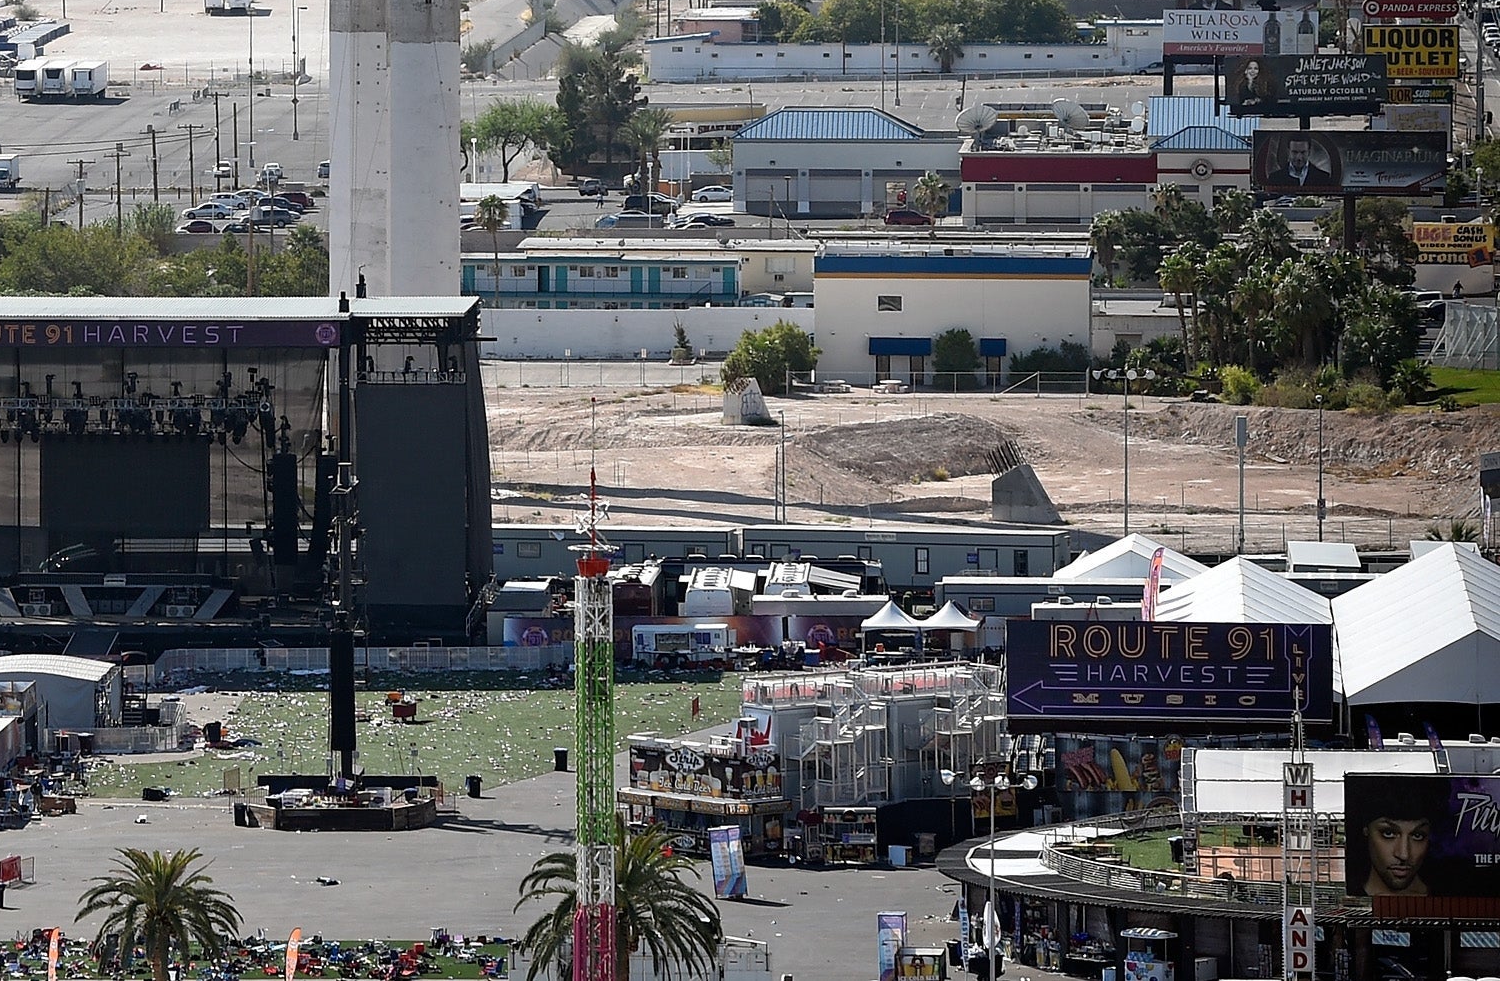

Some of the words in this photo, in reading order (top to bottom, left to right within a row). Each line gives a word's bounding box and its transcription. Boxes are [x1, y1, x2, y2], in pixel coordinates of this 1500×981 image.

[1382, 3, 1415, 12] PANDA
[1417, 3, 1458, 12] EXPRESS
[1167, 12, 1217, 28] STELLA
[1219, 12, 1260, 29] ROSA
[1191, 30, 1239, 41] WINES
[1366, 28, 1455, 50] LIQUOR
[1177, 44, 1213, 53] America's
[1215, 44, 1249, 53] Favorite!
[1295, 55, 1329, 73] JANET
[1328, 56, 1368, 71] JACKSON
[1374, 51, 1453, 65] UTLET
[1285, 74, 1309, 88] STATE
[1309, 74, 1320, 85] OF
[1322, 73, 1340, 85] THE
[1341, 72, 1371, 85] WORLD
[1329, 87, 1365, 95] OCTOBER
[1412, 89, 1449, 98] SUBWAY
[1346, 150, 1440, 163] IMAGINARIUM
[1456, 226, 1484, 235] CASH
[1453, 234, 1487, 243] BONUS
[1418, 252, 1469, 264] orona
[46, 323, 75, 343] 91
[83, 324, 245, 344] HARVEST
[1049, 624, 1211, 660] ROUTE
[1227, 625, 1274, 661] 91
[1086, 664, 1239, 684] HARVEST
[1291, 643, 1306, 701] LIVE
[1072, 692, 1257, 706] MUSIC
[669, 751, 701, 768] Strip
[694, 780, 712, 794] Beer
[1455, 792, 1500, 838] Pur
[1474, 853, 1492, 864] THE
[1290, 908, 1308, 970] AND
